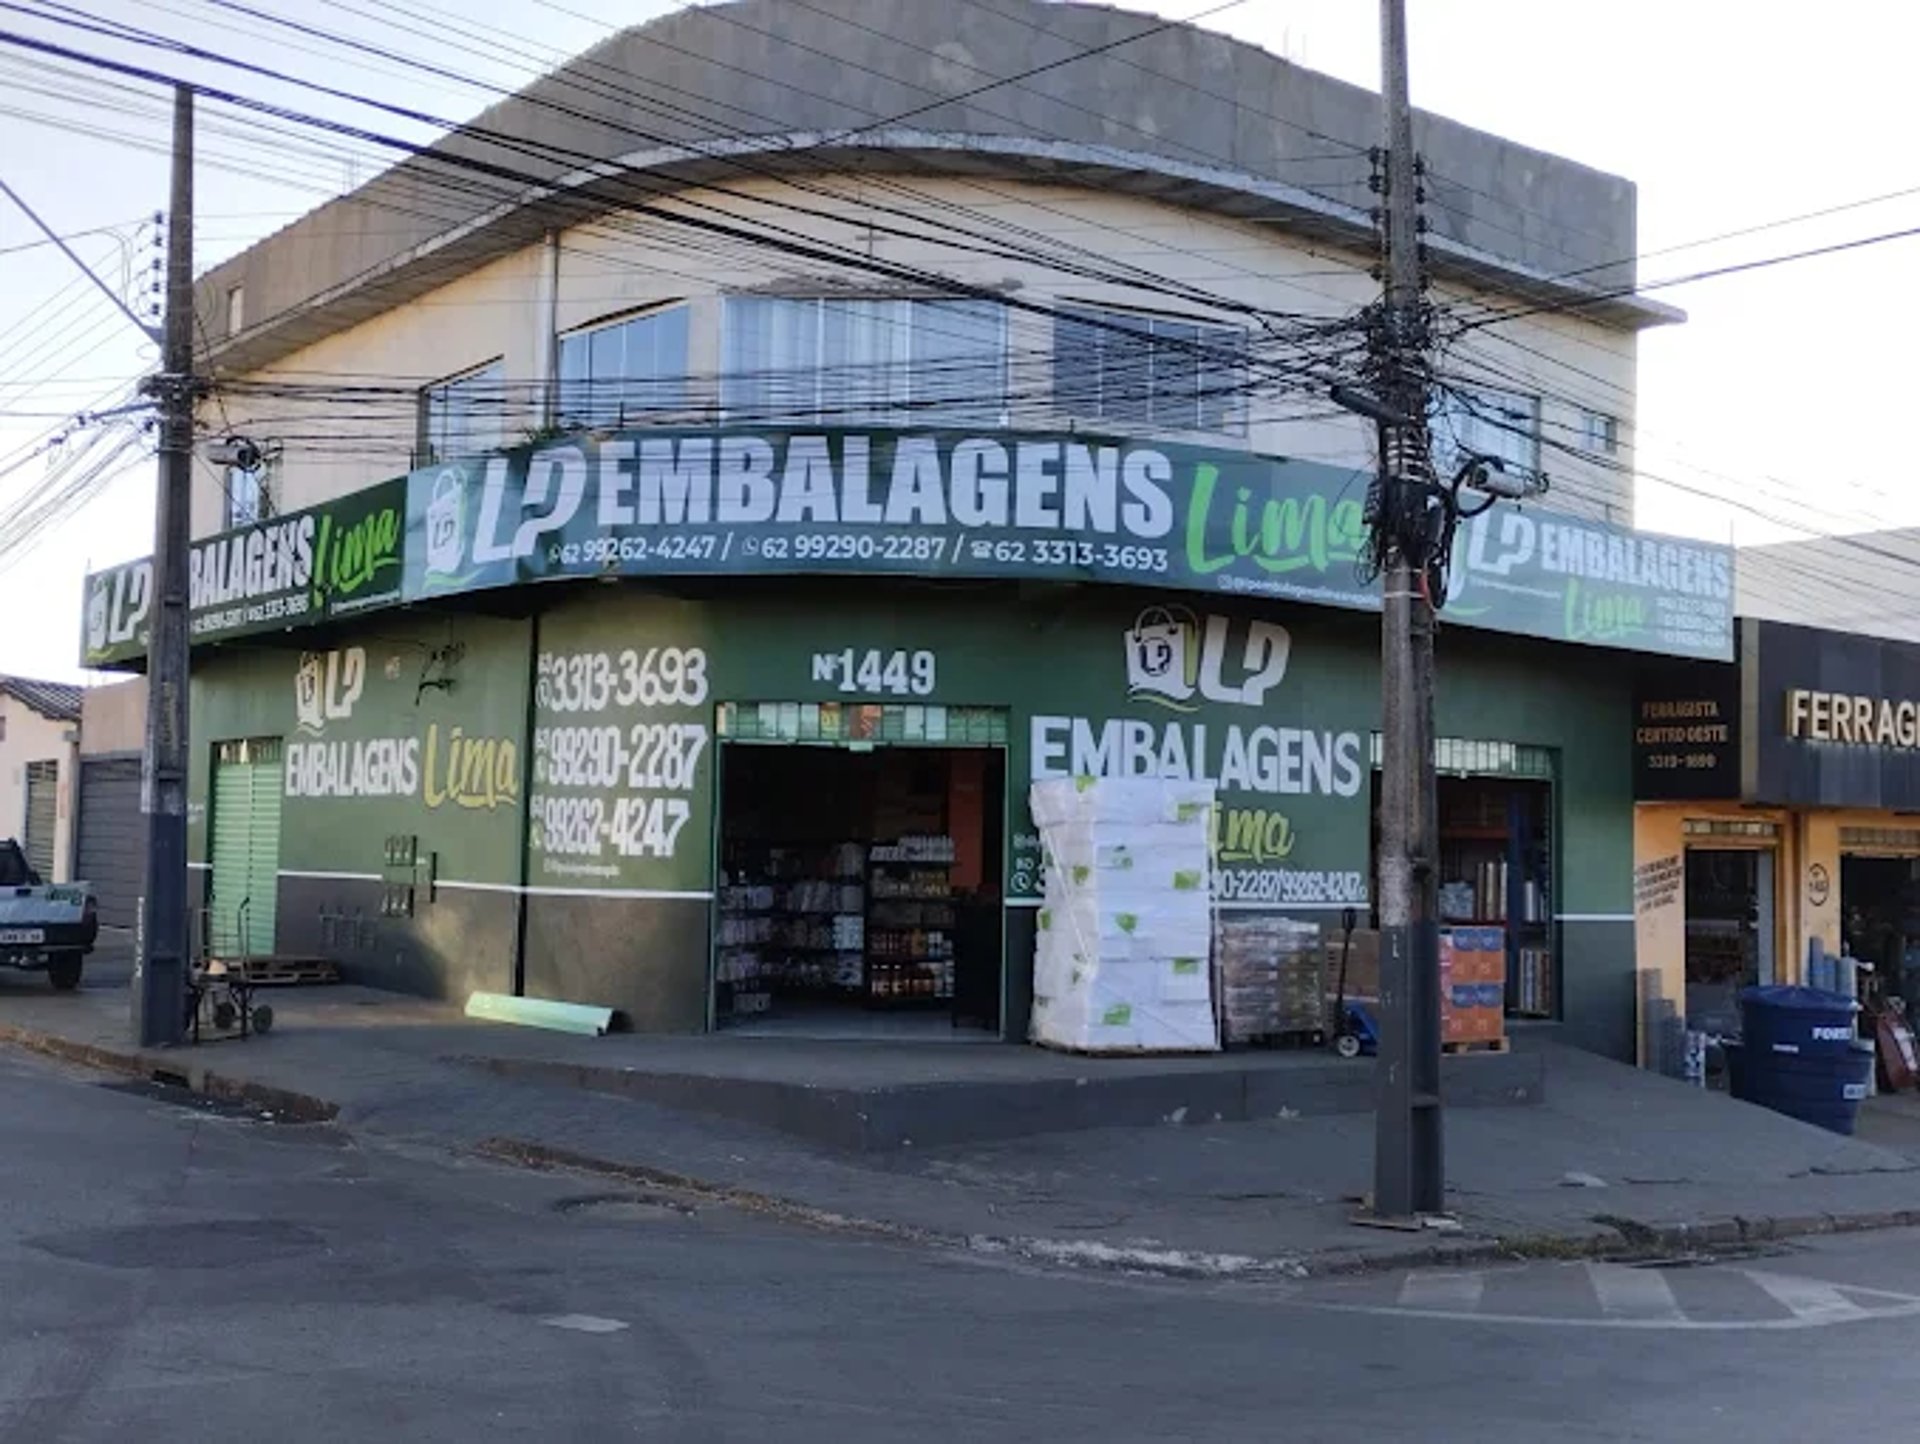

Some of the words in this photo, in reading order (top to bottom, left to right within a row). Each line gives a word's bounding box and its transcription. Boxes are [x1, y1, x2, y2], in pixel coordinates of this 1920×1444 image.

[472, 446, 588, 563] LP
[597, 434, 1173, 538] EMBALAGENS
[1186, 462, 1372, 574] Lima
[189, 515, 314, 612] BALAGENS
[312, 508, 400, 609] Lima
[562, 543, 580, 564] 62
[582, 534, 716, 563] 99262-4247
[761, 539, 788, 559] 62
[795, 534, 946, 560] 99290-2287
[994, 543, 1025, 563] 62
[1032, 539, 1168, 573] 3313-3693
[1540, 522, 1730, 599] EMBALAGENS
[1565, 576, 1649, 640] Lima
[325, 646, 366, 720] LP
[551, 647, 709, 713] 3313-3693
[1199, 614, 1292, 706] LP
[284, 737, 420, 797] EMBALAGENS
[423, 722, 518, 809] Lima
[548, 723, 708, 791] 99290-2287
[1030, 715, 1363, 797] EMBALAGENS
[544, 798, 690, 858] 99262-4247
[1210, 801, 1295, 864] ima
